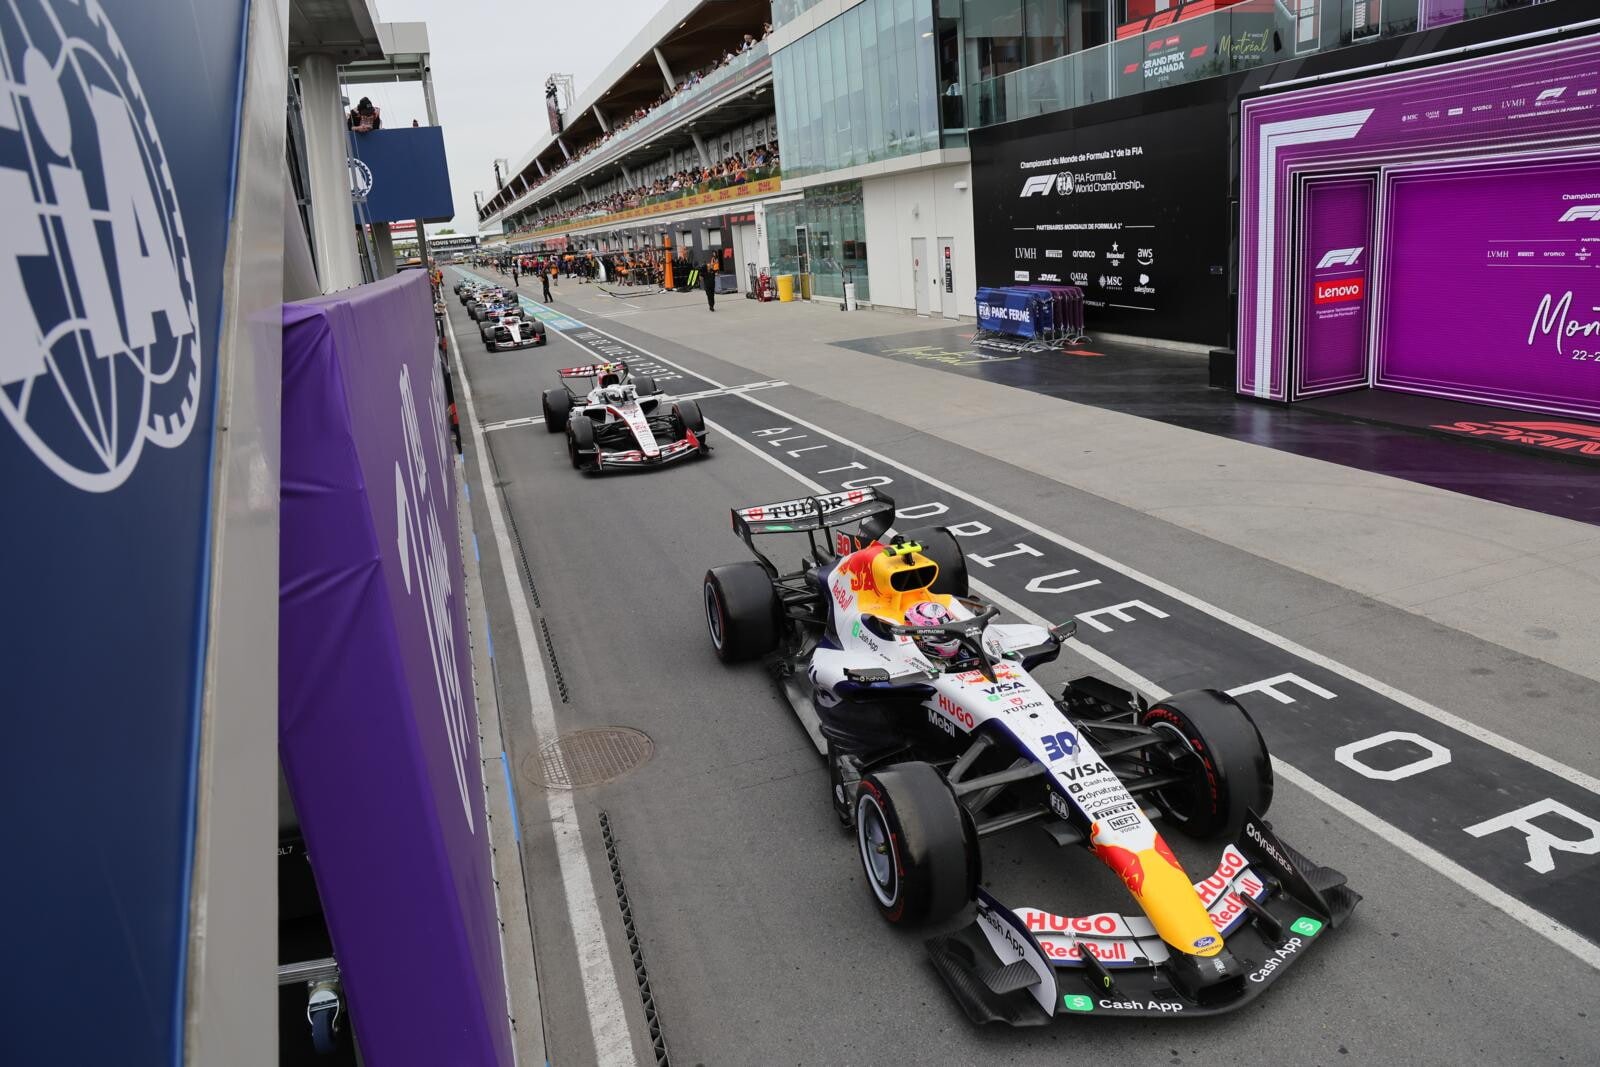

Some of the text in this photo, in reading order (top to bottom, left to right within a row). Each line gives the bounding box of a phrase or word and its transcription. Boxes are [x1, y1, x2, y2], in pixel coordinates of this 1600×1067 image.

[1144, 56, 1167, 68] GRAND
[1168, 51, 1185, 63] PRIX
[1154, 62, 1185, 76] CANADA
[1472, 104, 1492, 112] aramco
[1502, 99, 1526, 109] LVMH
[1020, 157, 1052, 169] Championnat
[1060, 154, 1078, 164] Monde
[1078, 153, 1086, 162] de
[1086, 150, 1110, 161] Formula
[1116, 149, 1124, 157] de
[1125, 147, 1131, 156] la
[1132, 146, 1143, 156] FIA
[1020, 174, 1057, 197] F1
[1074, 170, 1117, 183] FIA Formula 1
[1074, 183, 1093, 193] World
[1015, 248, 1037, 259] LVMH
[1072, 250, 1095, 258] aramco
[1138, 248, 1153, 258] aws
[1316, 247, 1364, 268] F1
[1487, 250, 1509, 258] LVMH
[1070, 272, 1088, 281] QATAR
[1107, 276, 1123, 286] MSC
[1319, 285, 1359, 299] Lenovo
[991, 307, 1008, 319] PARC
[1008, 308, 1030, 323] FERMÉ
[768, 496, 845, 519] TUDOR
[836, 532, 851, 556] 30
[752, 426, 1600, 874] ALL TO DRIVE FOR
[867, 639, 879, 652] App
[982, 681, 1026, 695] VISA
[938, 692, 974, 729] HUGO
[1002, 701, 1044, 715] TUDOR
[928, 709, 955, 738] Mobil
[1041, 731, 1081, 761] 30
[1058, 762, 1110, 781] VISA
[1083, 775, 1118, 788] Cash App
[1085, 784, 1125, 799] dynatrace
[1093, 793, 1132, 808] OCTAVE
[1092, 801, 1136, 820] PIRELLI
[1113, 816, 1136, 828] NEFT
[1254, 831, 1293, 876] dynatrace
[1199, 852, 1243, 905] HUGO
[1209, 896, 1241, 929] Red
[1026, 912, 1116, 934] HUGO
[1003, 926, 1025, 957] App
[1040, 941, 1127, 960] Red Bull
[1250, 957, 1283, 983] Cash
[1279, 937, 1302, 961] App
[1099, 999, 1183, 1013] Cash App
